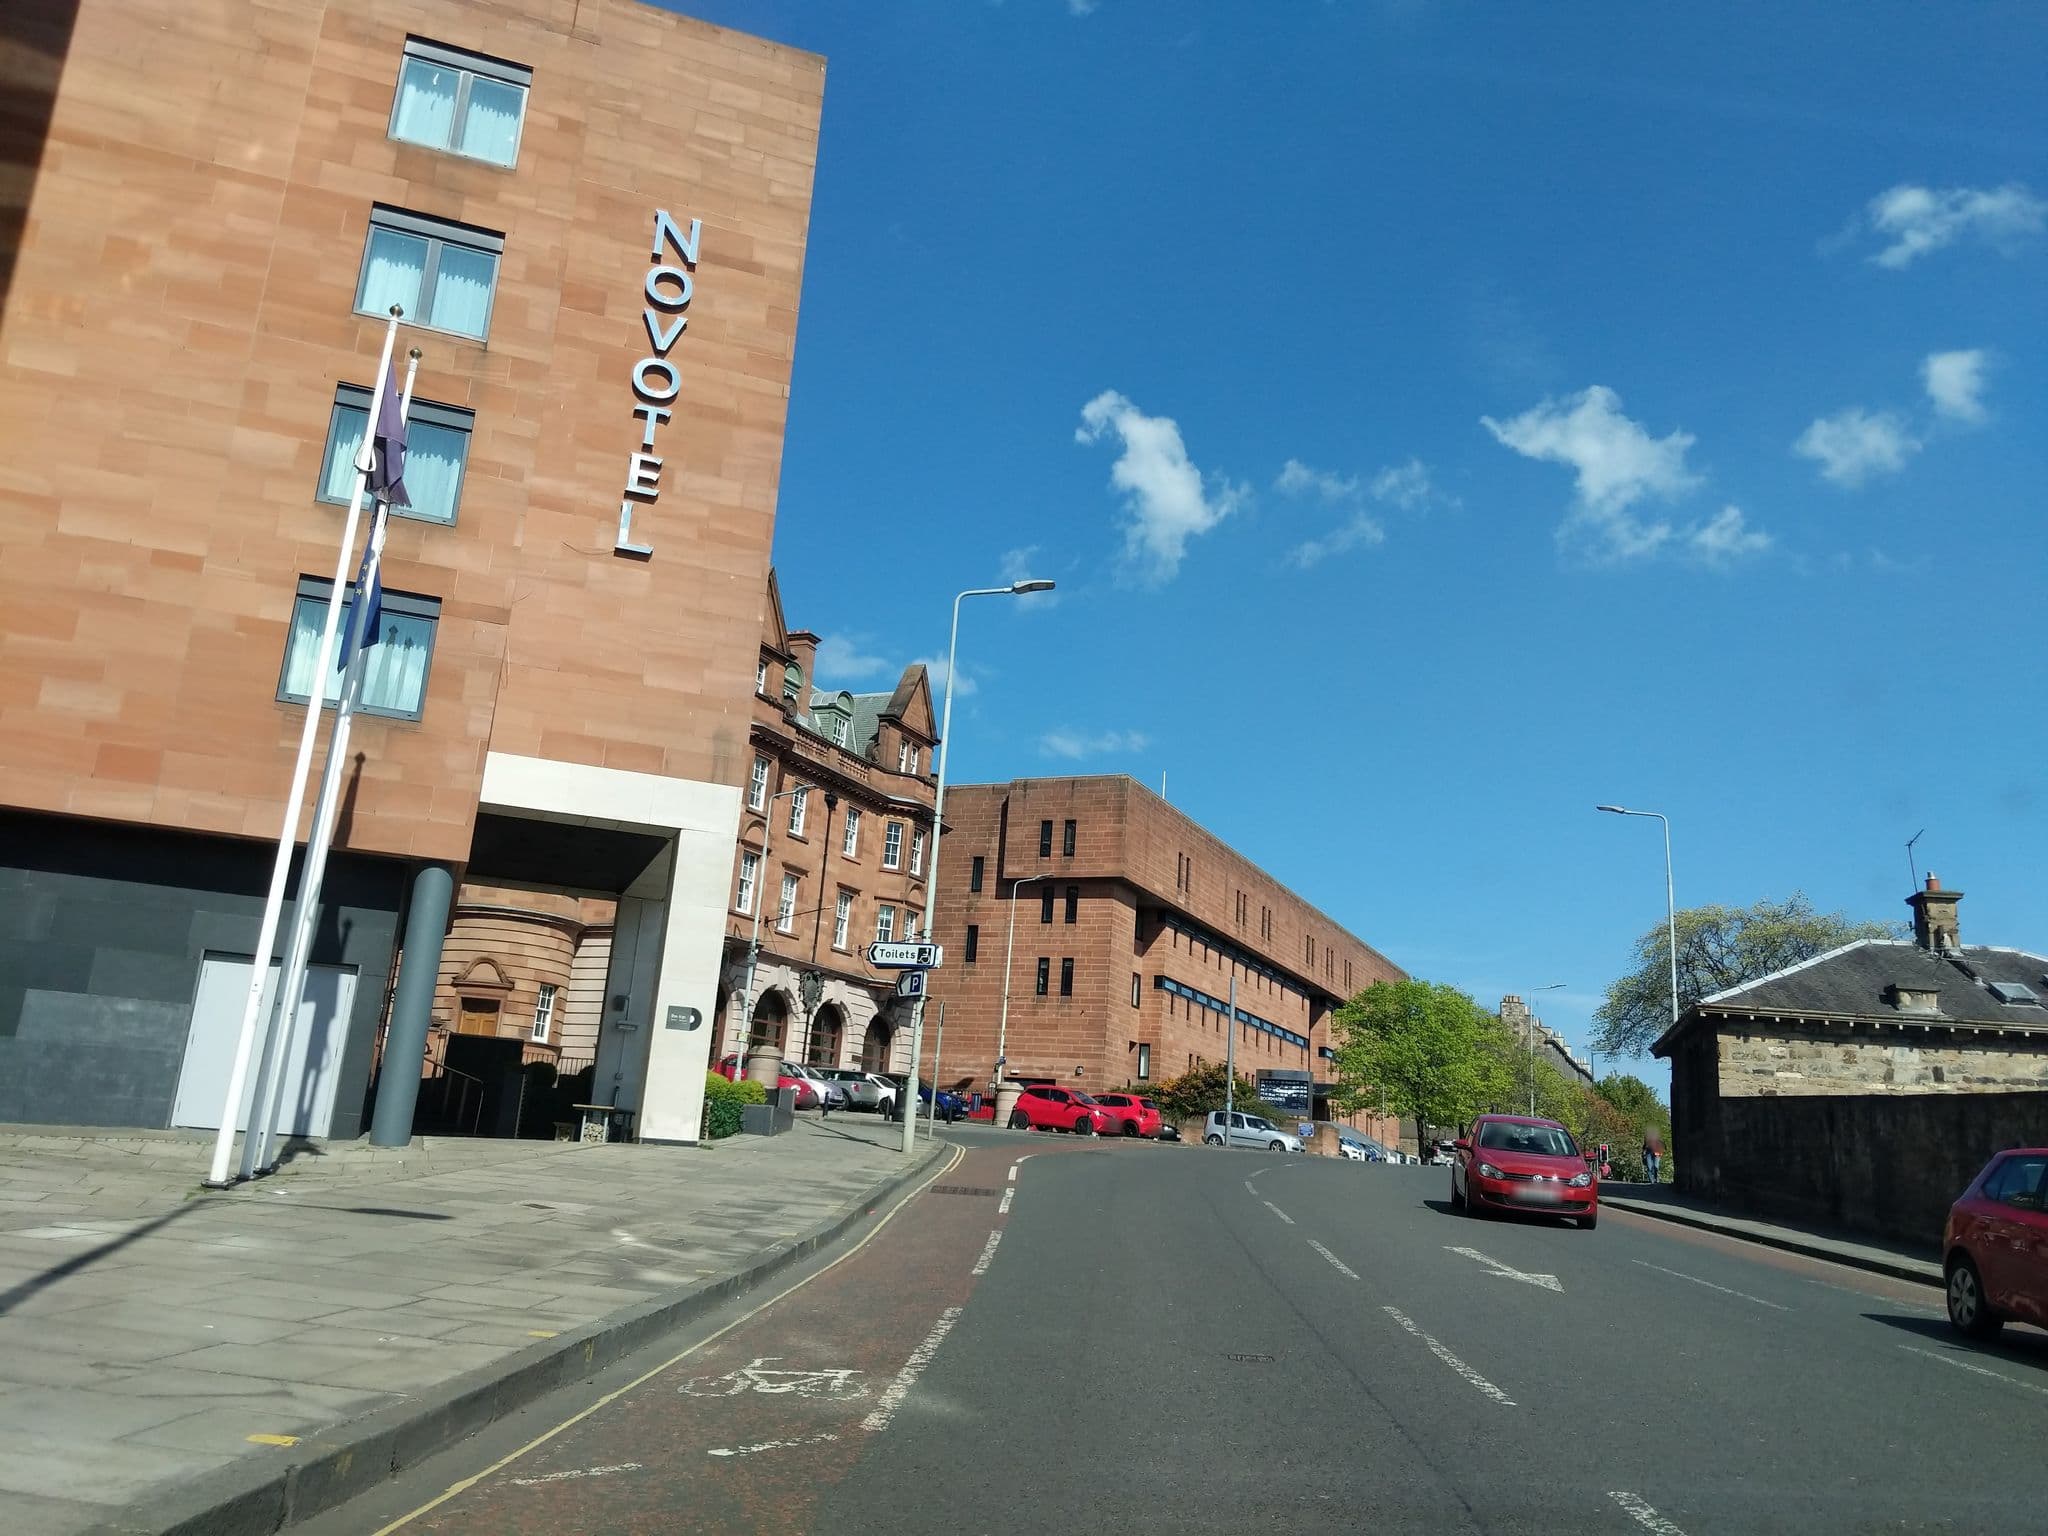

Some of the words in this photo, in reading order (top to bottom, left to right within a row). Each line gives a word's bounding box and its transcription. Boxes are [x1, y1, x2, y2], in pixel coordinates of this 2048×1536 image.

[614, 208, 703, 558] NOVOTEL
[879, 948, 917, 959] Toilets
[911, 976, 919, 991] P
